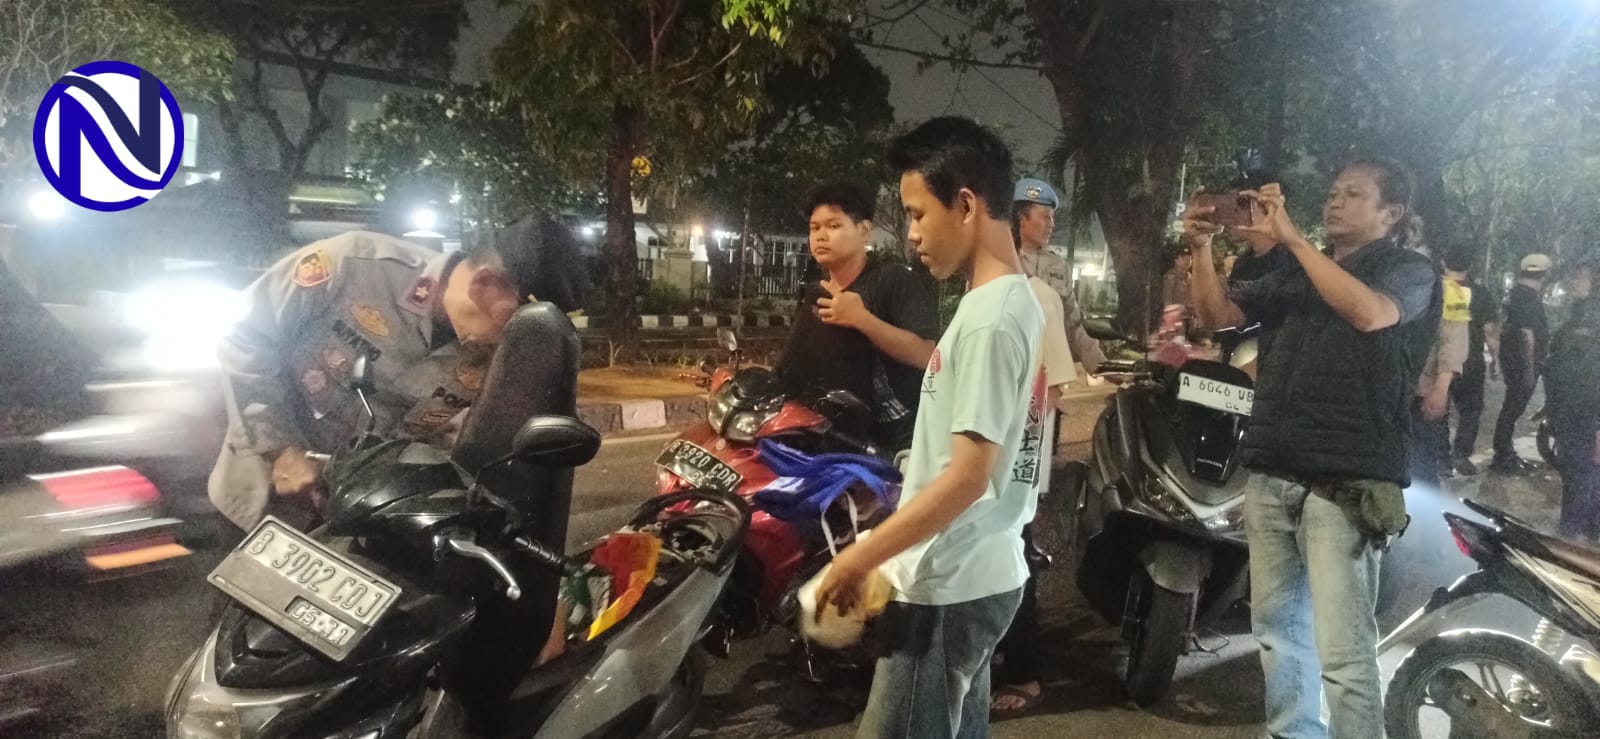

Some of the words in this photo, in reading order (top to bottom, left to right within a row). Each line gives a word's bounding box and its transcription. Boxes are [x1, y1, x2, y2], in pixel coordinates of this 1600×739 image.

[1182, 375, 1190, 387] A
[1199, 380, 1231, 397] 6046
[683, 442, 711, 468] 3920
[710, 462, 738, 487] CDR
[249, 530, 275, 556] B
[272, 543, 337, 593] 3902
[330, 576, 384, 619] CDJ
